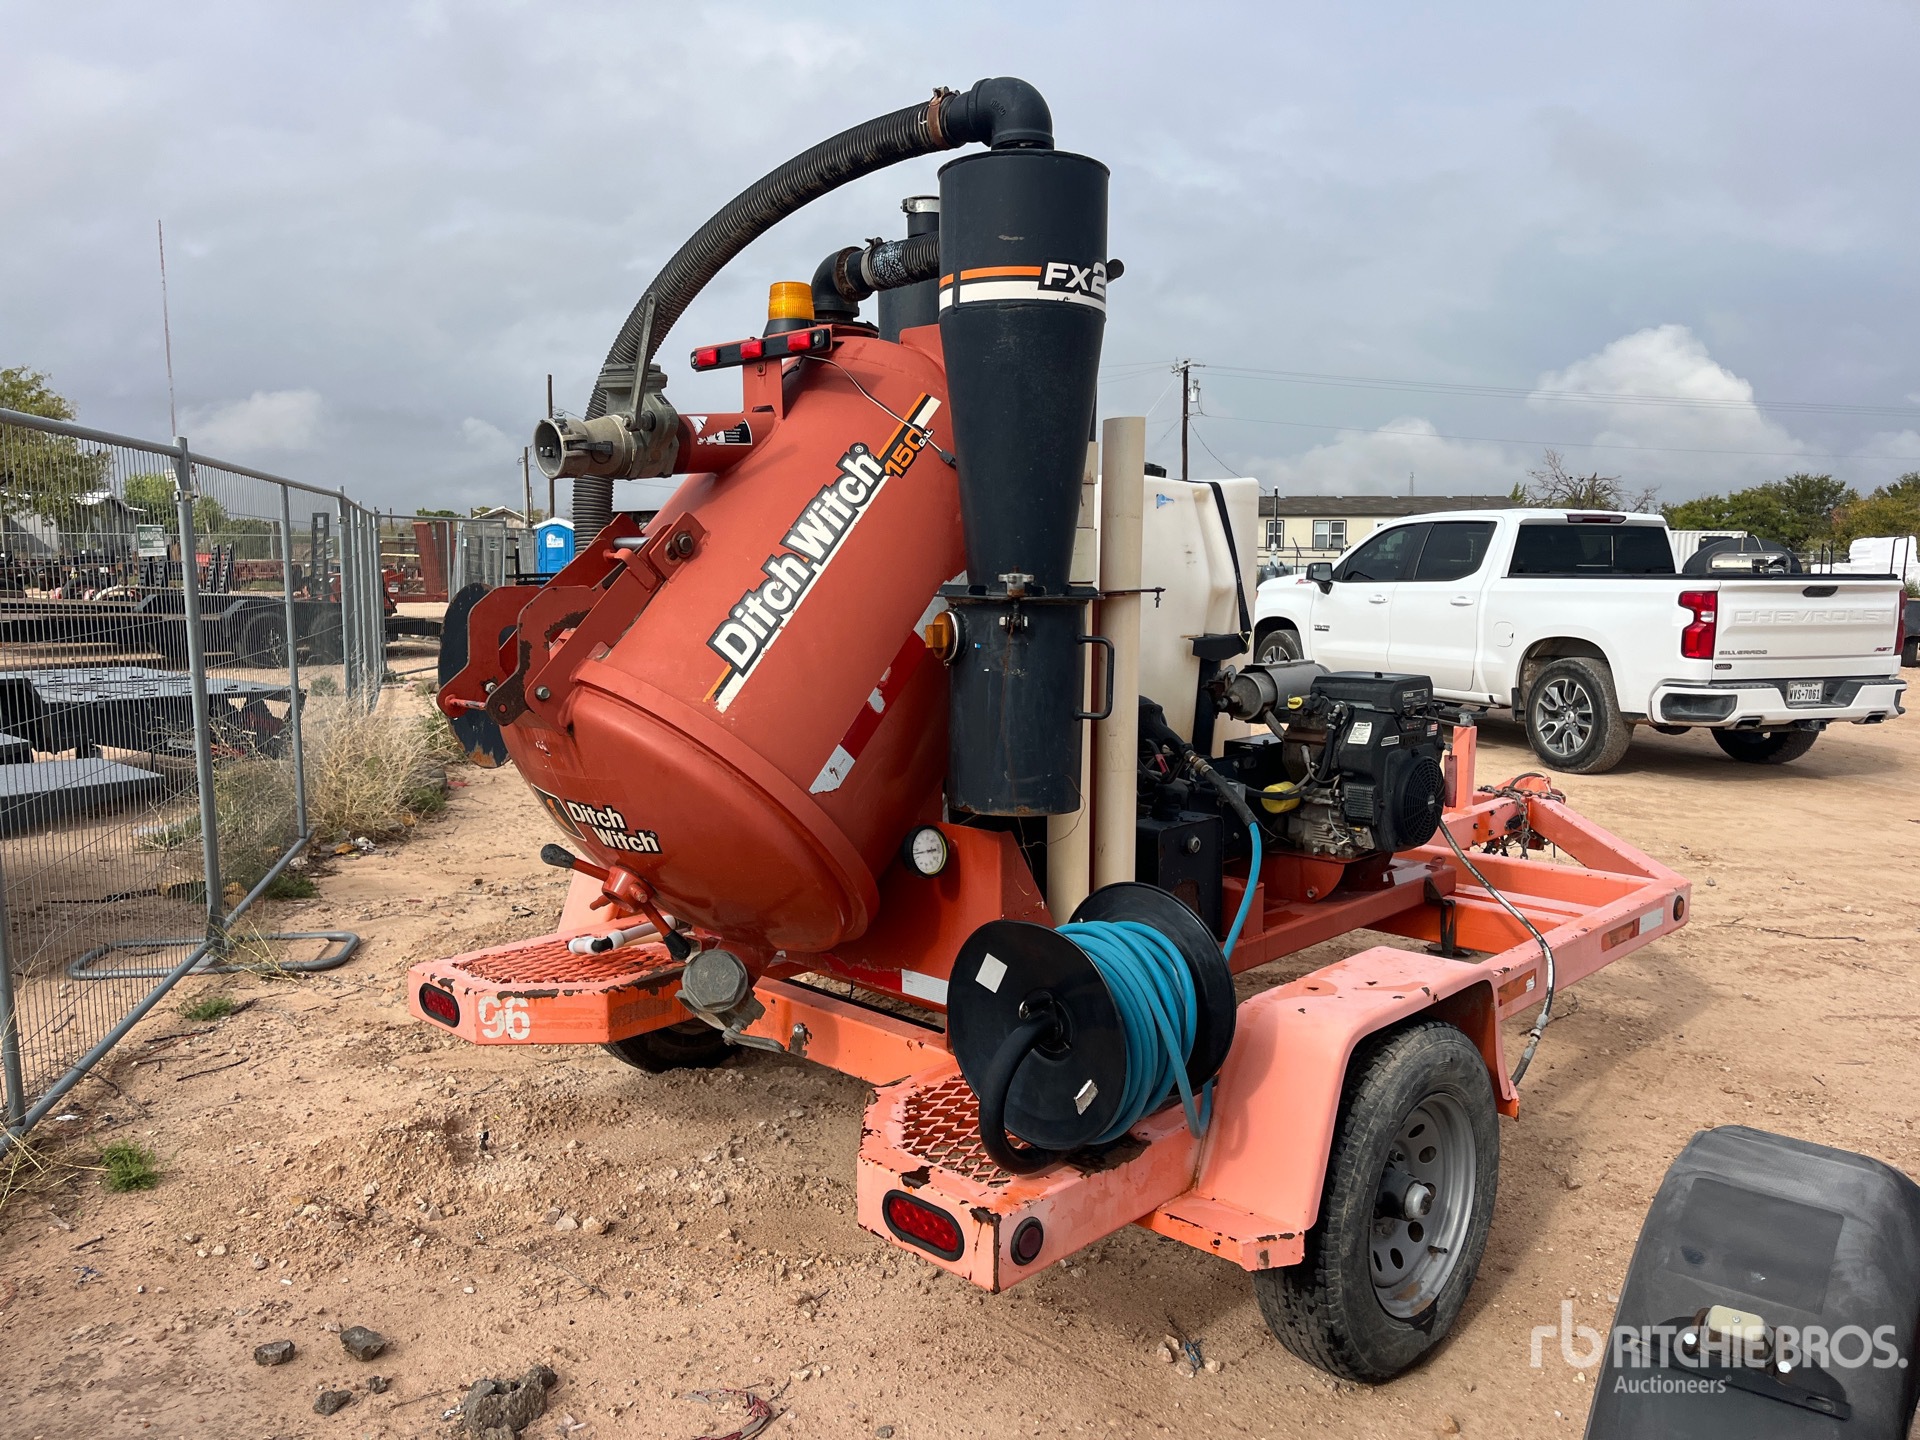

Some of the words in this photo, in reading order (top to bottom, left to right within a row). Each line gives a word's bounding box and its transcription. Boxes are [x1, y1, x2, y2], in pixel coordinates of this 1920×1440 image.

[885, 428, 923, 475] 150
[713, 556, 810, 669] Ditch
[787, 453, 883, 560] Witch
[1734, 609, 1892, 625] CHEVROLET
[566, 801, 626, 829] Ditch
[592, 826, 660, 852] Witch
